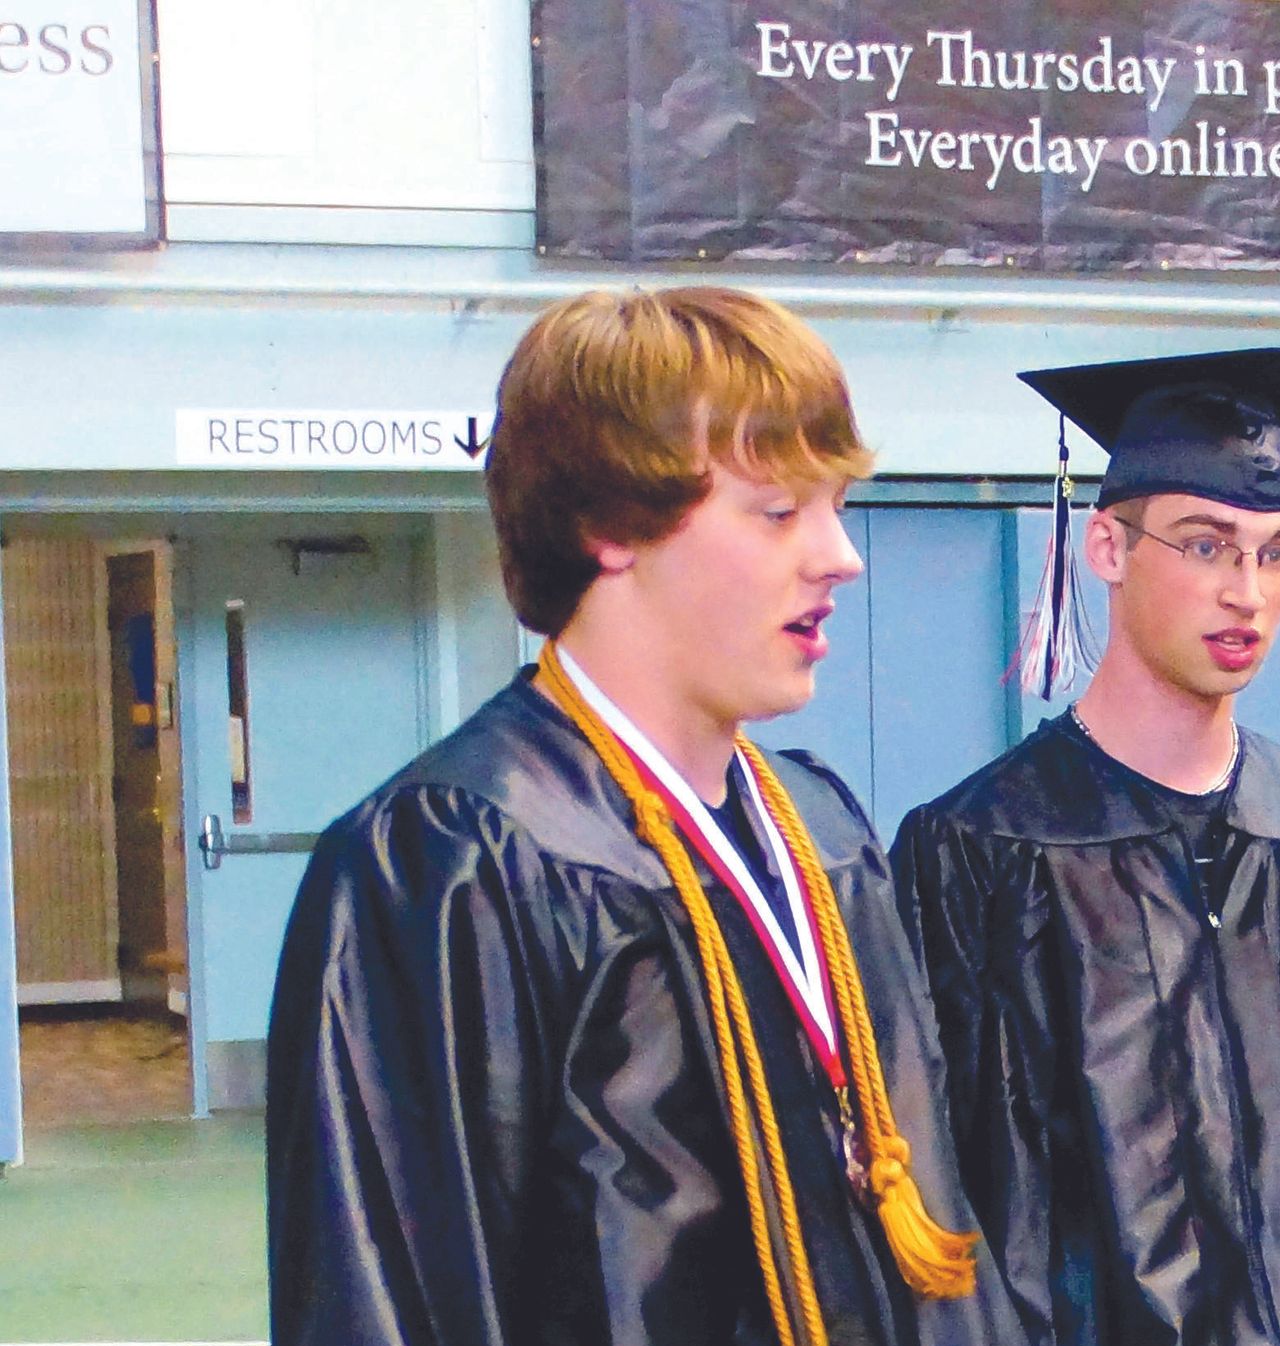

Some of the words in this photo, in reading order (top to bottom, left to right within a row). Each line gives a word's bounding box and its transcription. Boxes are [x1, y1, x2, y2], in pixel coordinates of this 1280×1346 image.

[755, 21, 914, 101] Every
[926, 29, 1175, 112] Thursday
[1195, 45, 1248, 95] in
[864, 111, 1109, 192] Everyday
[208, 419, 442, 455] RESTROOMS
